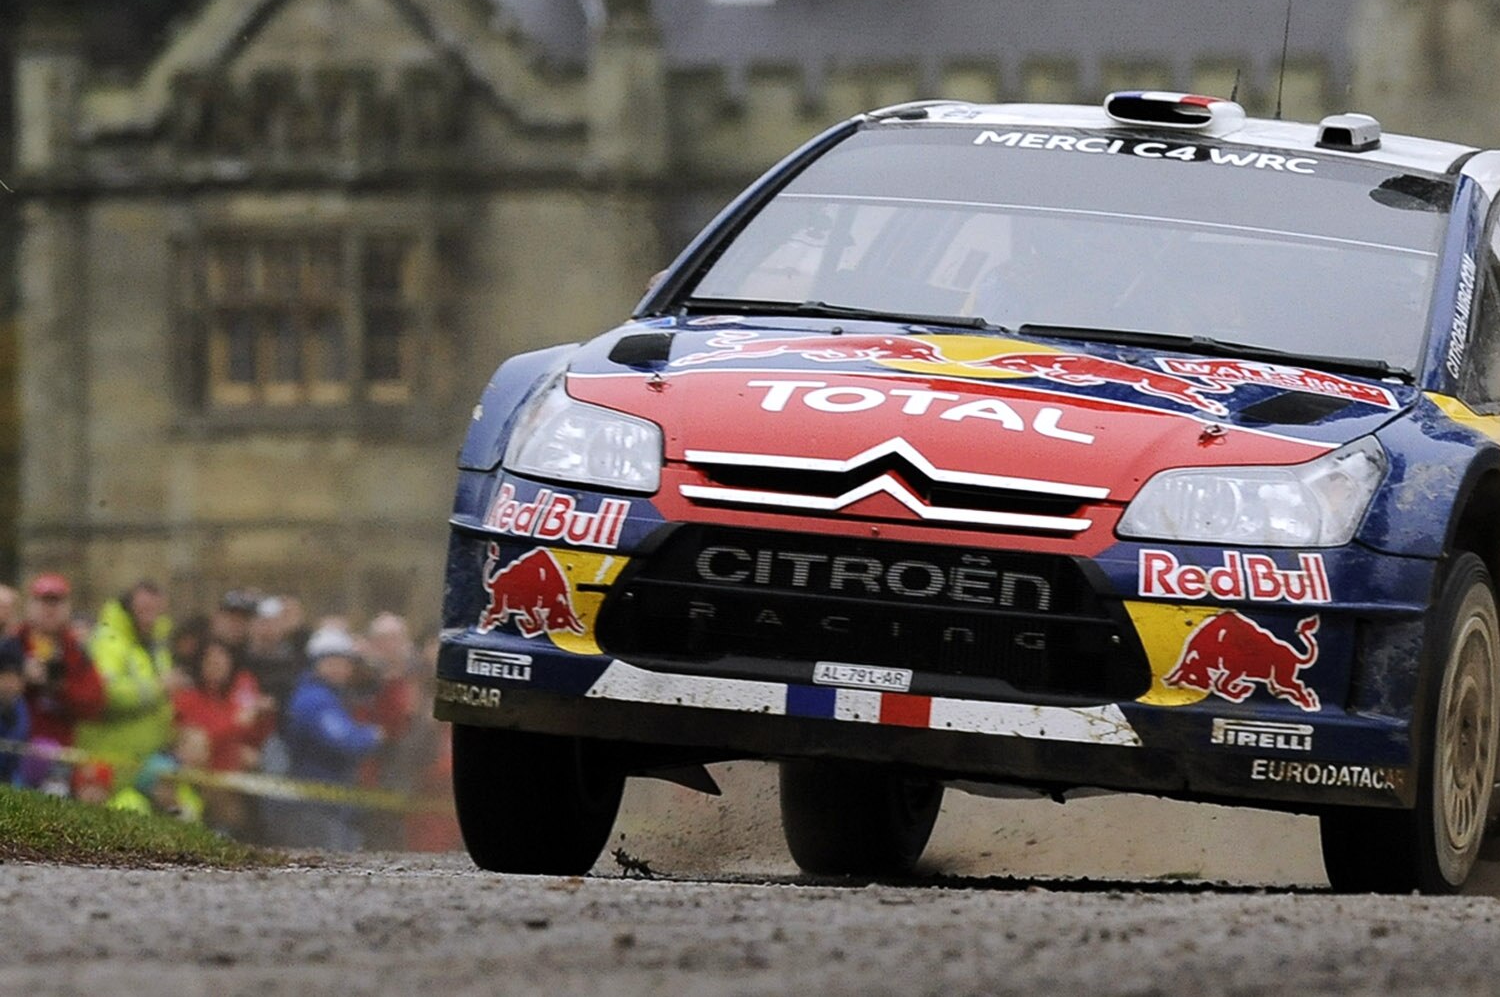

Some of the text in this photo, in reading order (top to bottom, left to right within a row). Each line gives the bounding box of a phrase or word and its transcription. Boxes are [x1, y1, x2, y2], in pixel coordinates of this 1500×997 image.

[973, 130, 1319, 174] MERCI C4 WRC
[747, 379, 1095, 444] TOTAL
[484, 483, 631, 549] Red Bull
[1138, 550, 1331, 603] Red Bull
[466, 648, 533, 681] PIRELLI
[820, 666, 905, 686] AL-791-AR
[1211, 718, 1314, 751] PIRELLI
